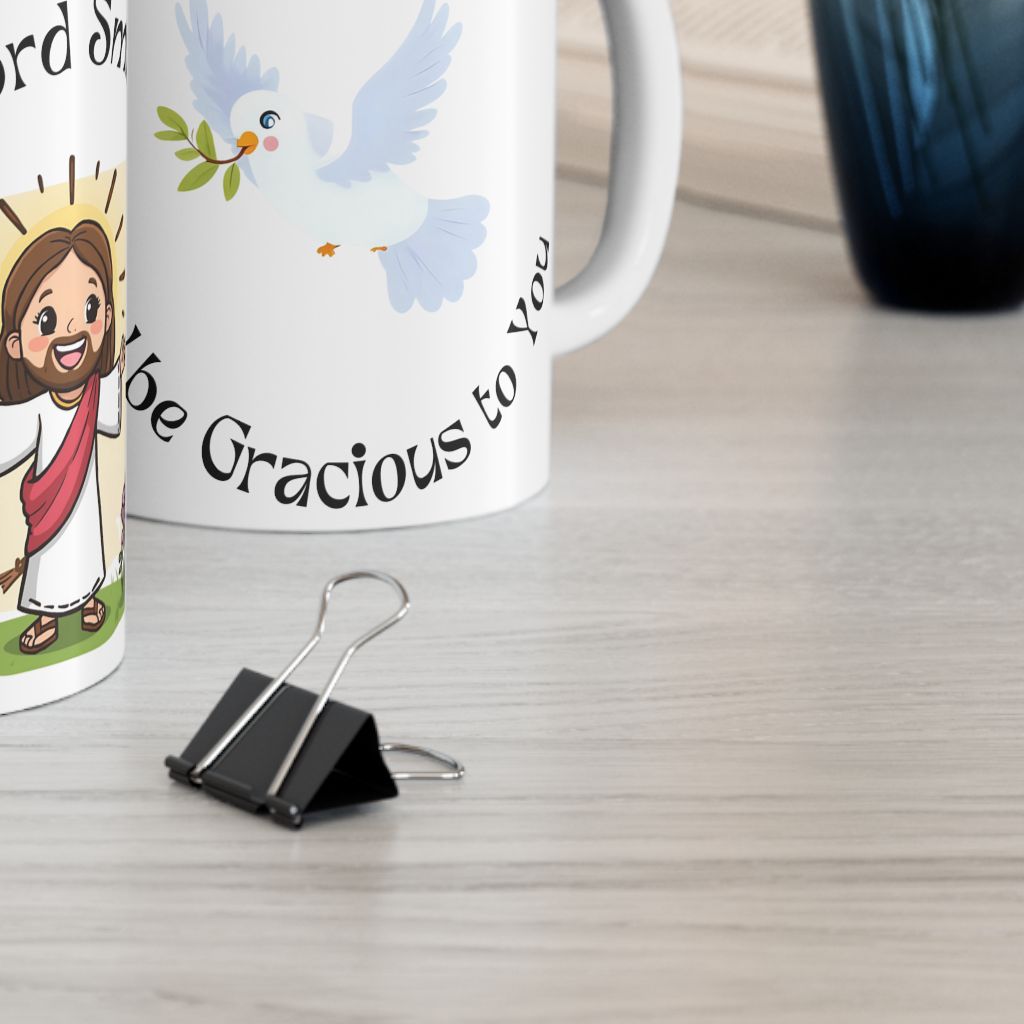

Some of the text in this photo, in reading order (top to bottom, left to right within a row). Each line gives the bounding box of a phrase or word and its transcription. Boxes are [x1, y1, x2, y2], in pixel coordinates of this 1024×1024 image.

[125, 235, 551, 510] be Gracious to You
